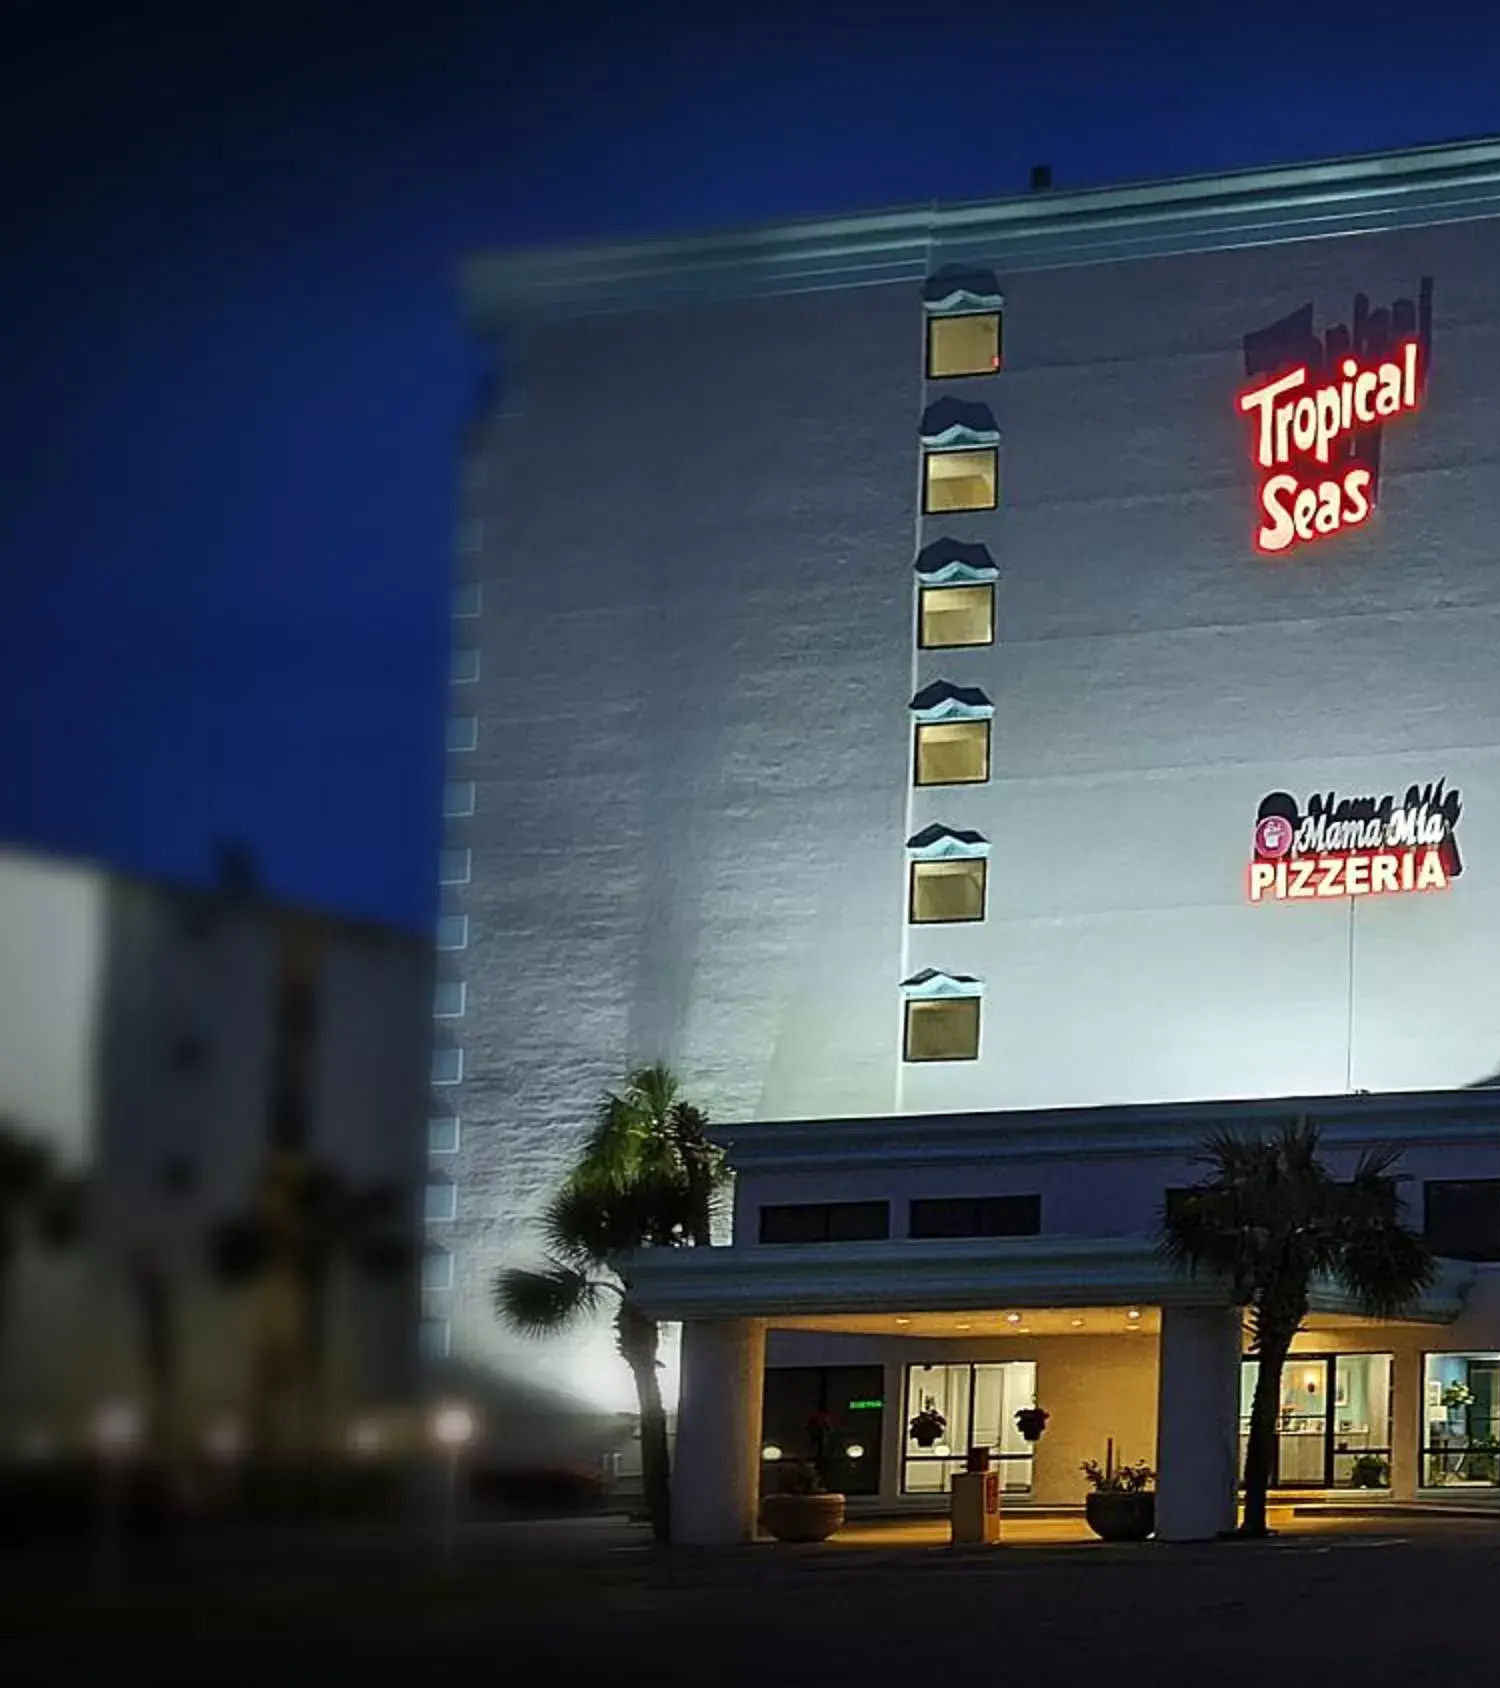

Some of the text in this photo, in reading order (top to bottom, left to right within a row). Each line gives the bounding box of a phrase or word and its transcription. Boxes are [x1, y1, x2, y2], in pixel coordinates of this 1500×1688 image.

[1241, 343, 1417, 467] Tropical
[1259, 469, 1370, 550] Seas
[1292, 814, 1386, 854] Mama
[1251, 851, 1447, 900] PIZZERIA
